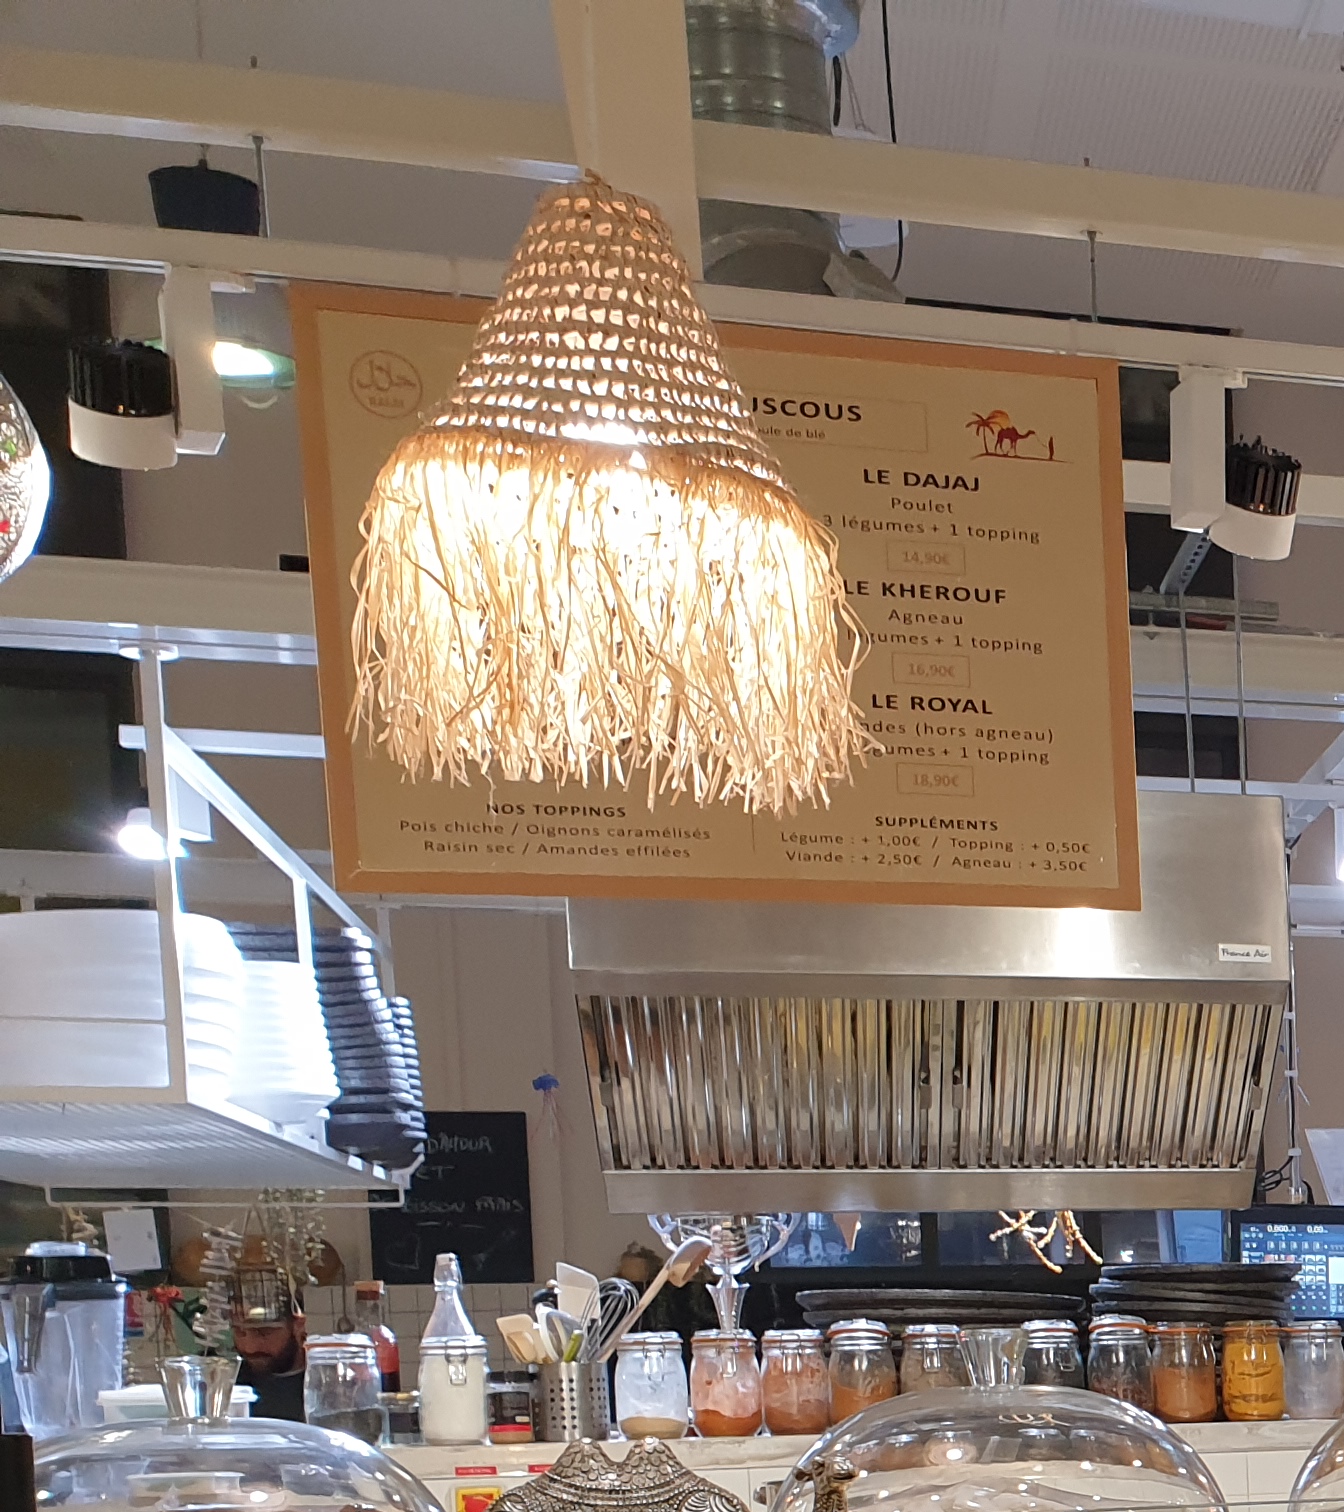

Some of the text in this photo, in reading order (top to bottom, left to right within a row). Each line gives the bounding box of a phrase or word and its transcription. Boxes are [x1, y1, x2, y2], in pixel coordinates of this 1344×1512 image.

[863, 469, 980, 492] LE DAJAJ
[891, 497, 954, 514] Poulet
[823, 515, 833, 528] 3
[842, 516, 925, 534] légumes
[950, 524, 958, 537] 1
[967, 525, 1040, 544] topping
[844, 579, 1007, 605] LE KHEROUF
[888, 608, 964, 626] Agneau
[954, 635, 963, 647] 1
[971, 637, 1044, 655] topping
[872, 694, 993, 715] LE ROYAL
[915, 721, 967, 738] (hors
[975, 728, 1054, 745] agneau)
[961, 746, 969, 758] 1
[978, 747, 1050, 766] topping
[486, 803, 627, 818] NOS TOPPINGS
[399, 820, 437, 833] Pois
[444, 820, 504, 835] chiche
[526, 823, 600, 838] Oignons
[607, 825, 711, 841] caramélisés
[875, 814, 999, 832] SUPPLÉMENTS
[424, 839, 479, 854] Raisin
[486, 841, 515, 854] sec
[536, 842, 619, 858] Amandes
[626, 844, 691, 859] effilées
[781, 831, 844, 846] Légume
[878, 835, 921, 848] 1,00€
[950, 837, 1014, 853] Topping
[1046, 841, 1091, 854] 0,50€
[785, 850, 844, 865] Viande
[951, 855, 1012, 871] Agneau
